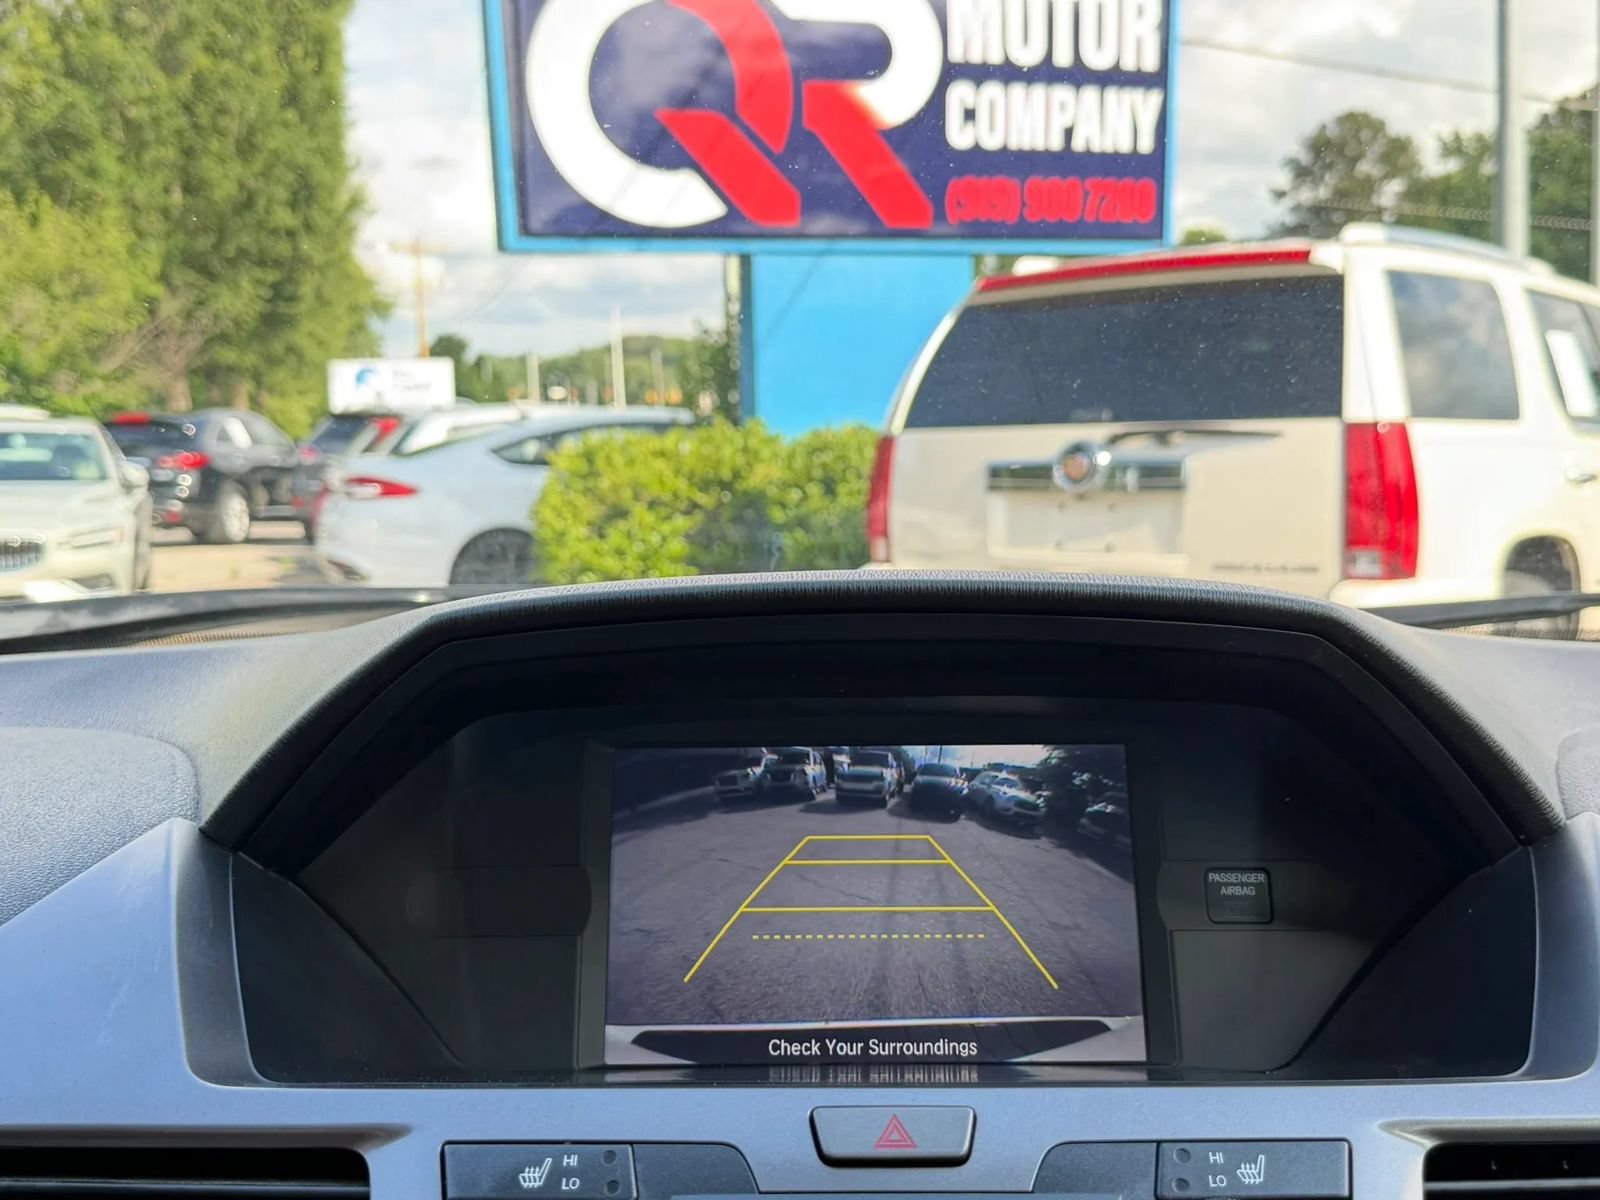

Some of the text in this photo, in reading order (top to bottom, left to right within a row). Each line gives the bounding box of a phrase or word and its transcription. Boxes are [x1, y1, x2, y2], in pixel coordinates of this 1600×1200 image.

[946, 0, 1162, 72] MOTOR
[945, 79, 1164, 154] COMPANY
[1208, 872, 1265, 883] PASSENGER
[1220, 885, 1256, 896] AIRBAG
[768, 1039, 978, 1057] Check Your Surroundings
[563, 1154, 578, 1166] HI
[1208, 1151, 1224, 1164] HI
[561, 1177, 580, 1190] LO
[1208, 1174, 1226, 1187] LO
